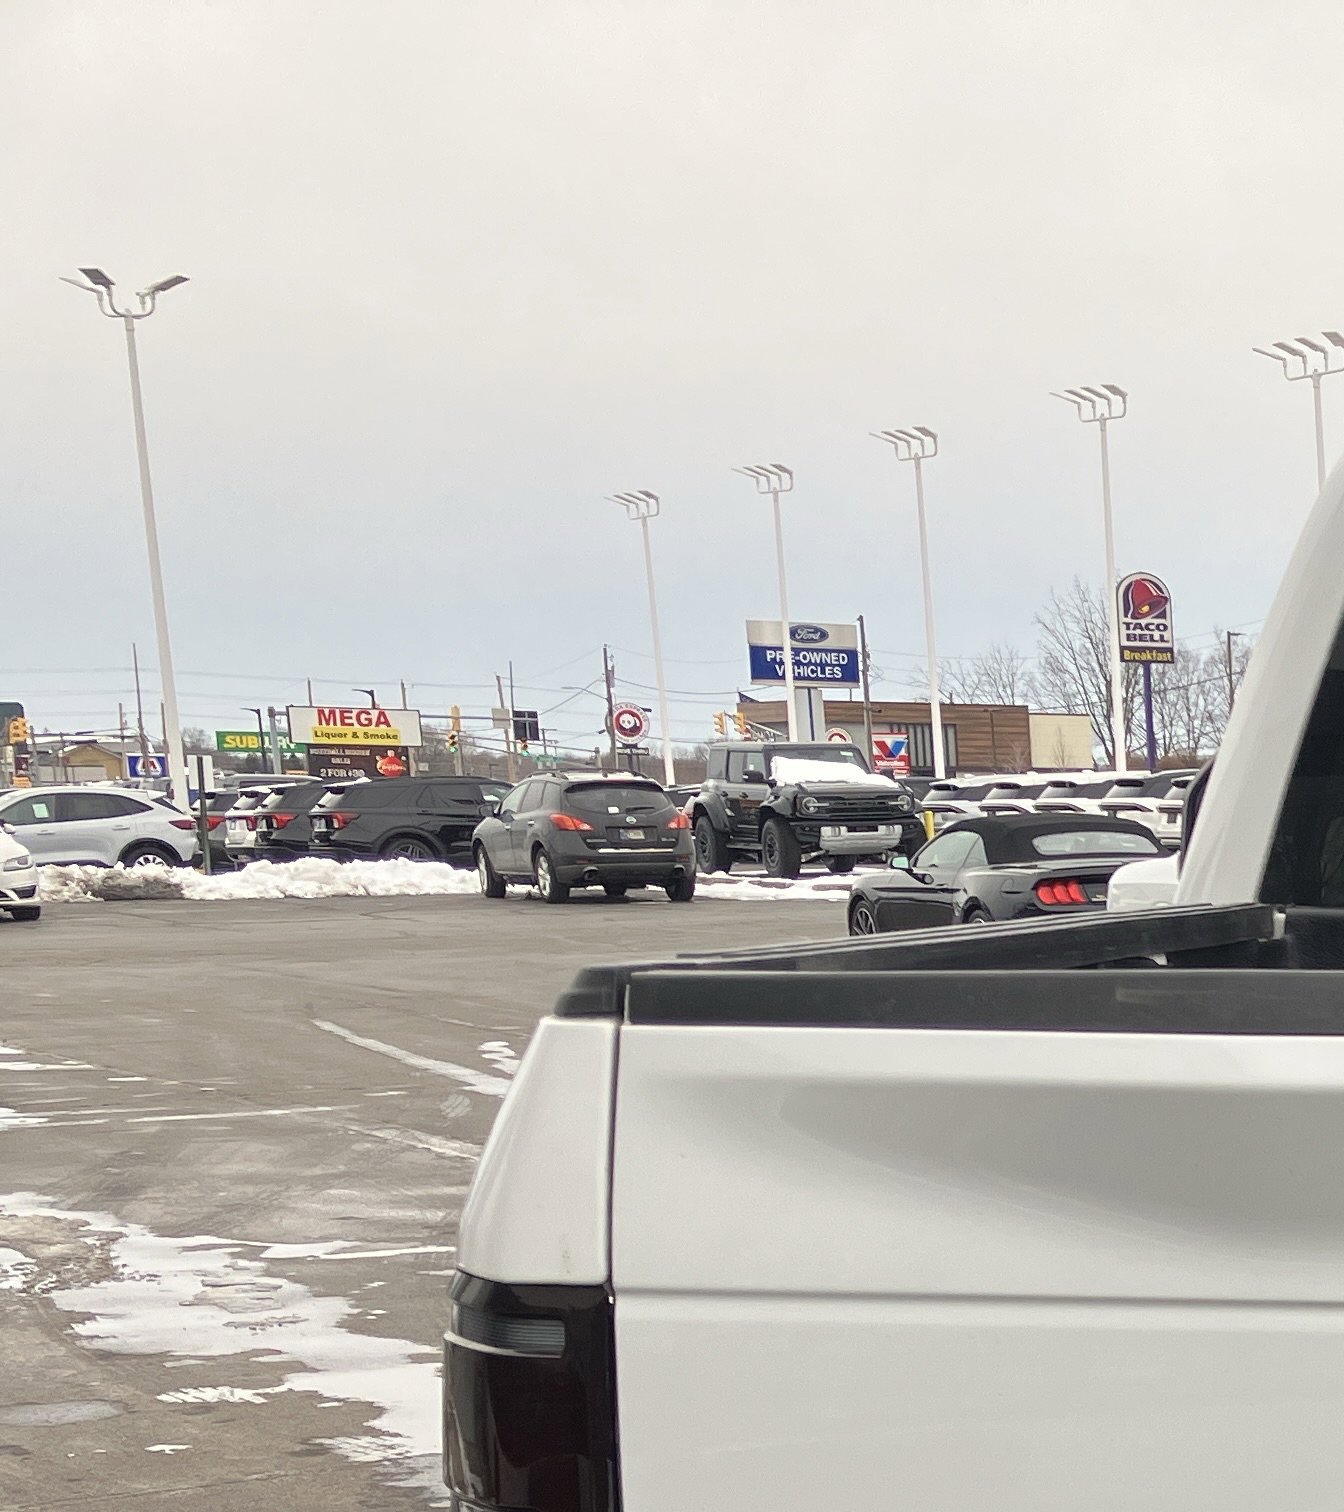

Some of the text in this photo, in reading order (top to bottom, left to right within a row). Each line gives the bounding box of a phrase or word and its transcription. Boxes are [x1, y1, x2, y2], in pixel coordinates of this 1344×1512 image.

[1122, 622, 1169, 632] TACO
[796, 628, 821, 640] Ford
[1126, 633, 1170, 643] BELL
[1123, 649, 1172, 662] Breakfast
[775, 664, 842, 679] VHICLES
[317, 708, 391, 728] MEGA
[314, 730, 399, 741] Liquor & Smoke
